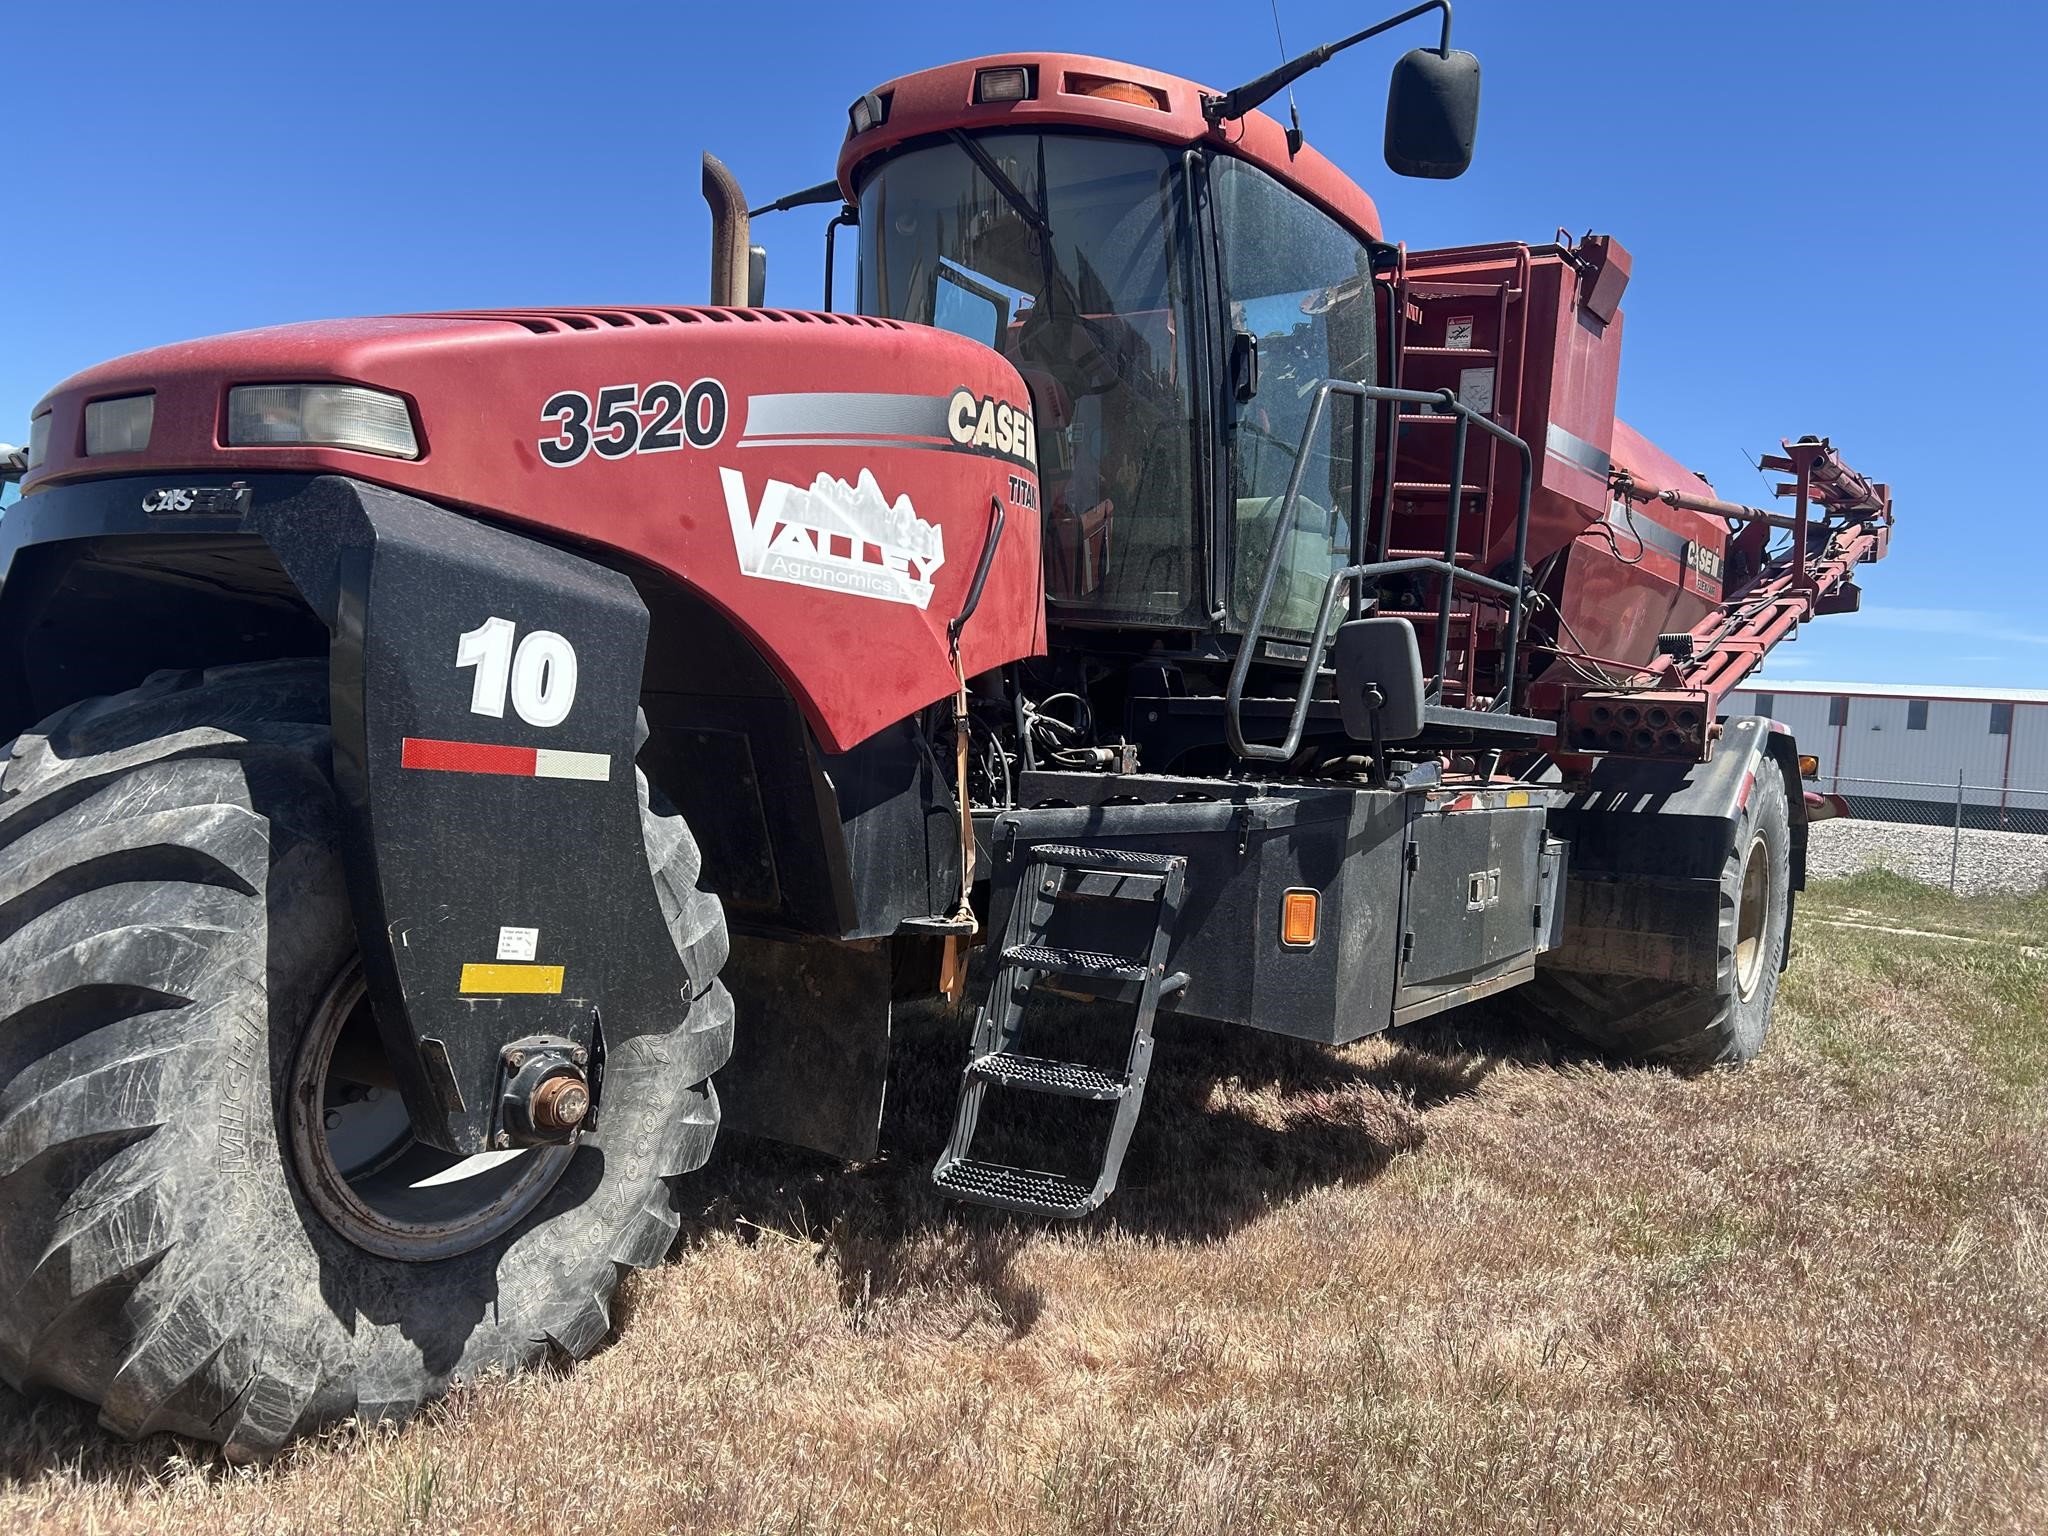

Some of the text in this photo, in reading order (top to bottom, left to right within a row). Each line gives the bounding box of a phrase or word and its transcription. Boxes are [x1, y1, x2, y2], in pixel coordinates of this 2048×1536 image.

[538, 376, 728, 468] 3520
[719, 467, 945, 584] VALLEY
[1008, 475, 1037, 511] TITAN
[770, 556, 893, 594] Agronomics
[456, 616, 577, 728] 10
